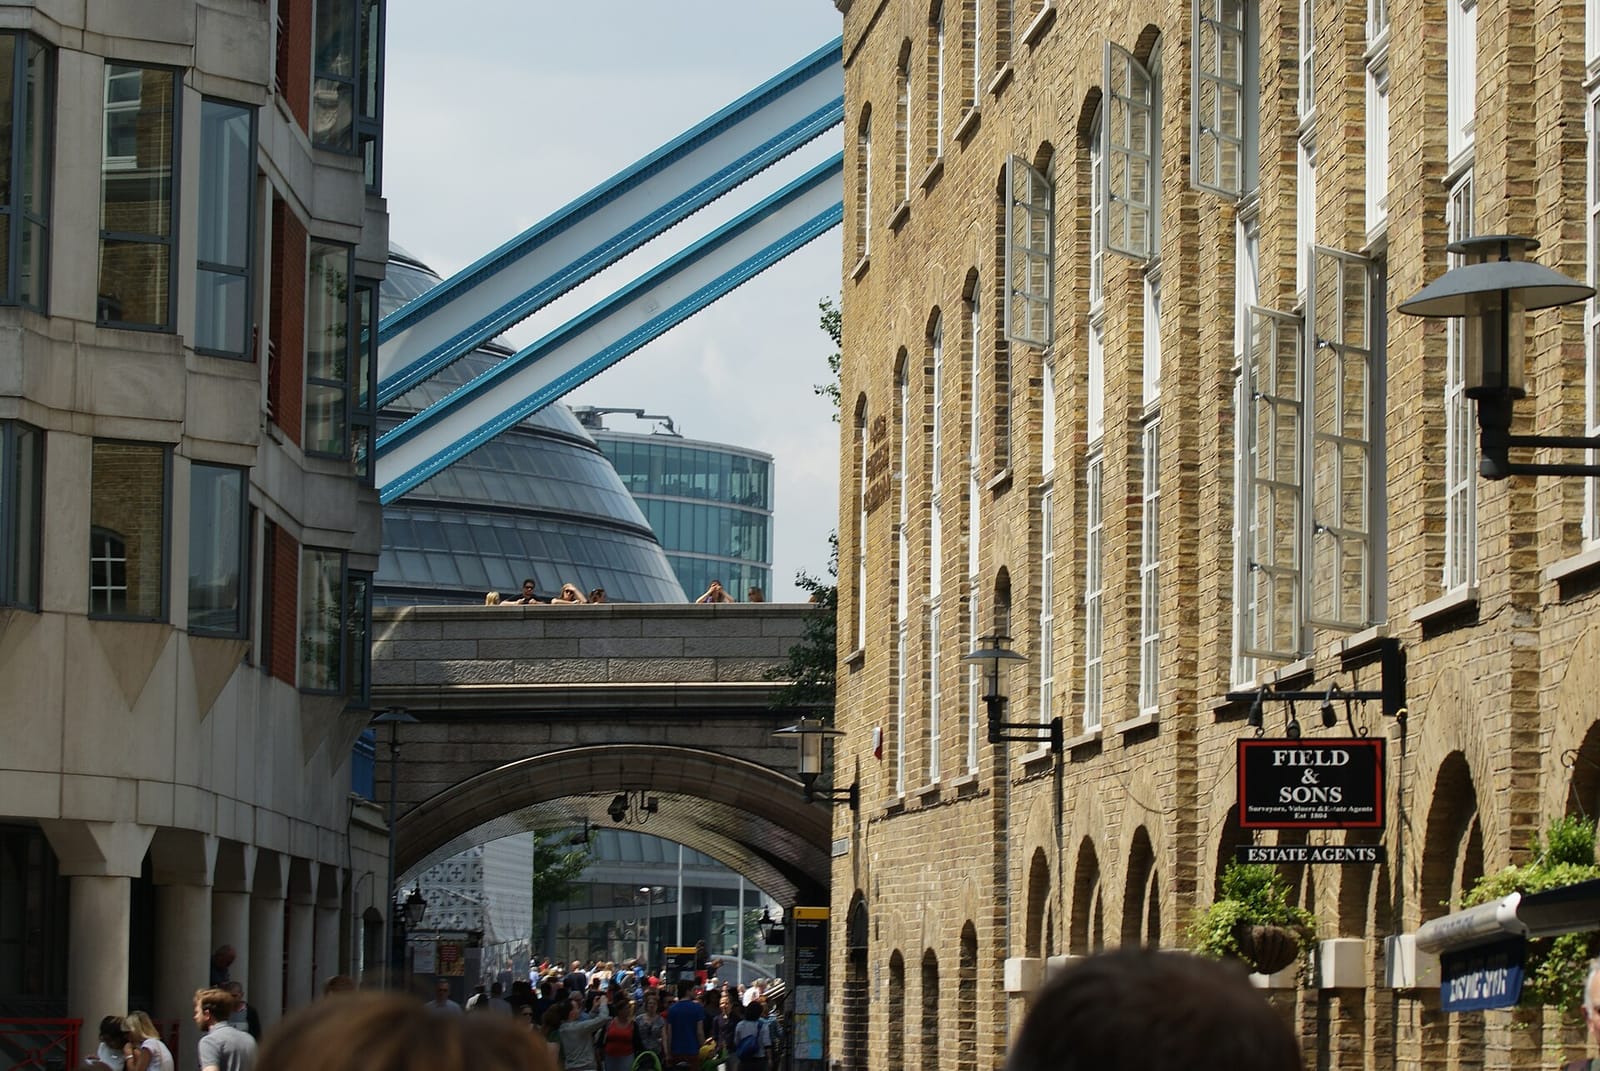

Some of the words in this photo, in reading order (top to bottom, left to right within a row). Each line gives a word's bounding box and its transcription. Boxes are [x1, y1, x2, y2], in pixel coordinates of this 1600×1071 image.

[1272, 750, 1350, 766] FIELD
[1301, 768, 1320, 784] &
[1279, 786, 1342, 803] SONS
[1248, 805, 1287, 814] Surveyors,
[1348, 805, 1373, 813] Agents
[1247, 848, 1307, 861] ESTATE
[1310, 848, 1376, 861] AGENTS
